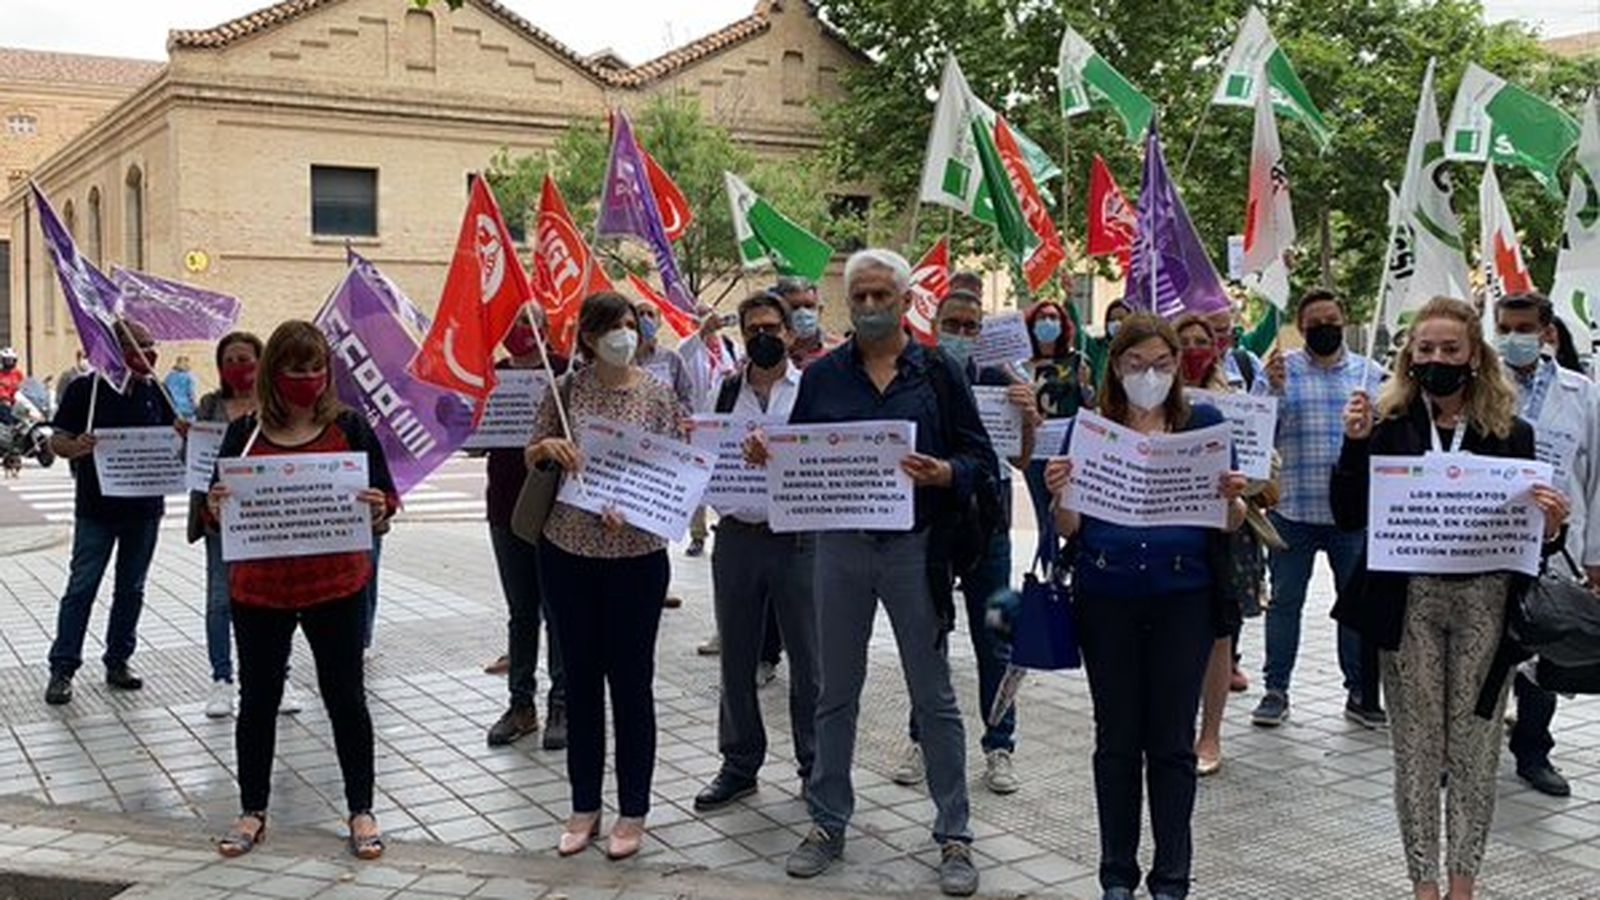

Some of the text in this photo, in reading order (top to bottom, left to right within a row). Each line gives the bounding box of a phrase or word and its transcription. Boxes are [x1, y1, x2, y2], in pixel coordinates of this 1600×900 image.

[799, 456, 878, 465] LOS SINDICATOS
[1102, 453, 1122, 465] LOS
[255, 487, 274, 496] LOS
[1410, 490, 1507, 501] LOS SINDICATOS
[806, 494, 818, 502] LA
[1407, 505, 1439, 514] MESA
[1511, 506, 1527, 514] DE
[1444, 519, 1459, 527] EN
[1463, 519, 1510, 528] CONTRA
[1513, 519, 1527, 527] DE
[1415, 533, 1430, 541] LA
[1434, 533, 1488, 542] EMPRESA
[1450, 547, 1498, 557] DIRECTA
